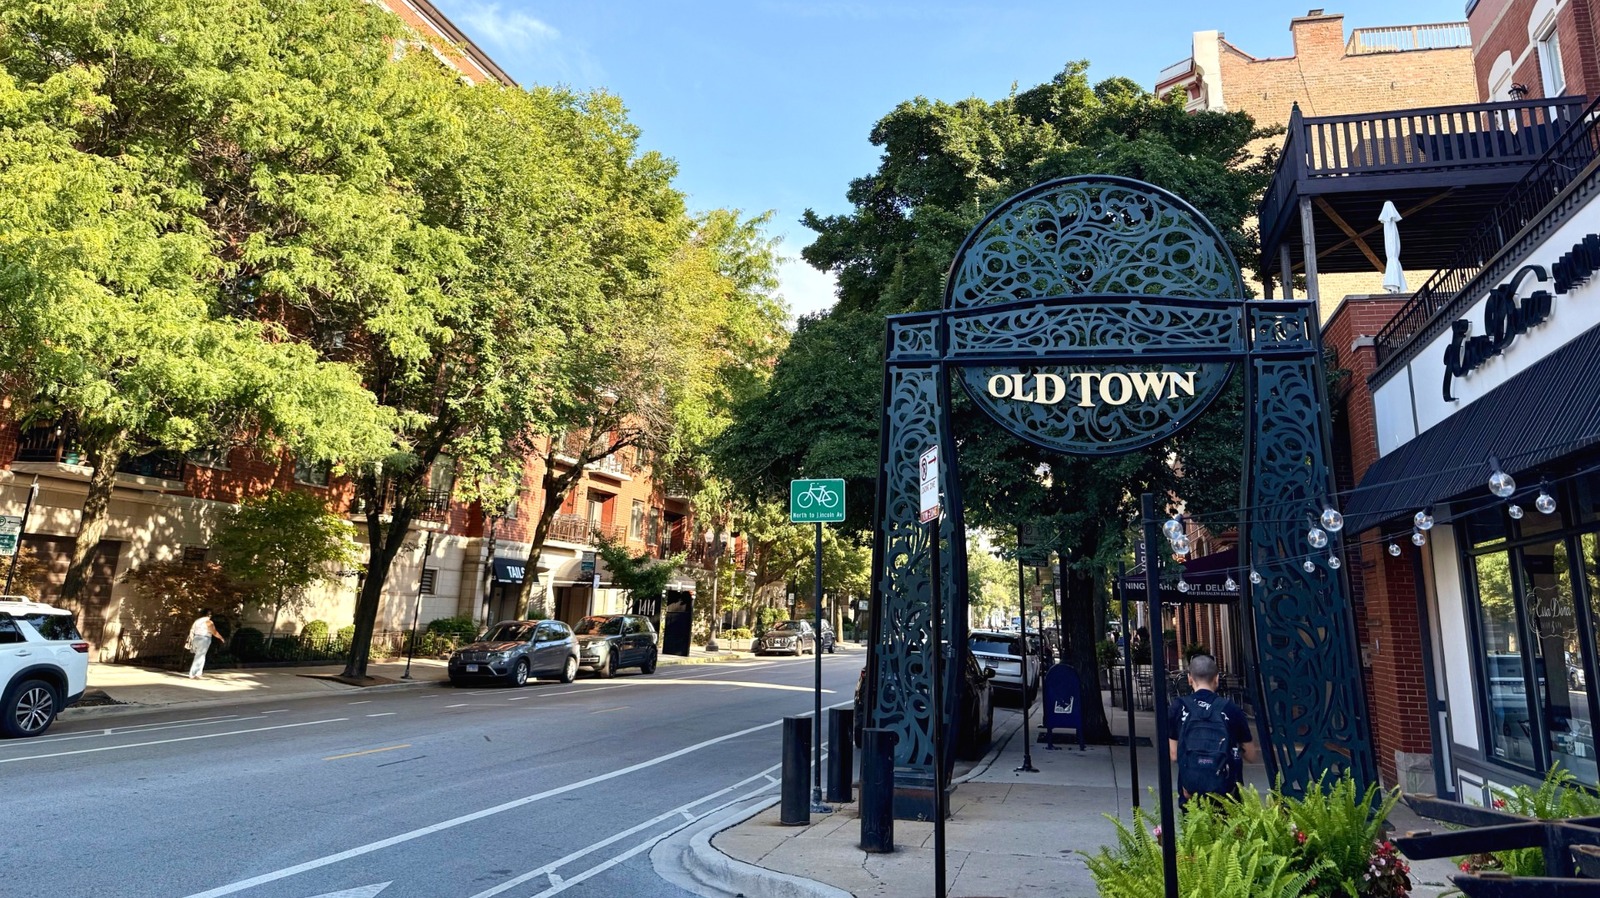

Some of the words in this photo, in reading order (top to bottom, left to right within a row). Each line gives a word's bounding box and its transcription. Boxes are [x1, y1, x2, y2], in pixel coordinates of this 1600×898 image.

[987, 373, 1066, 405] OLD
[1070, 371, 1197, 407] TOWN
[638, 599, 656, 616] 1414
